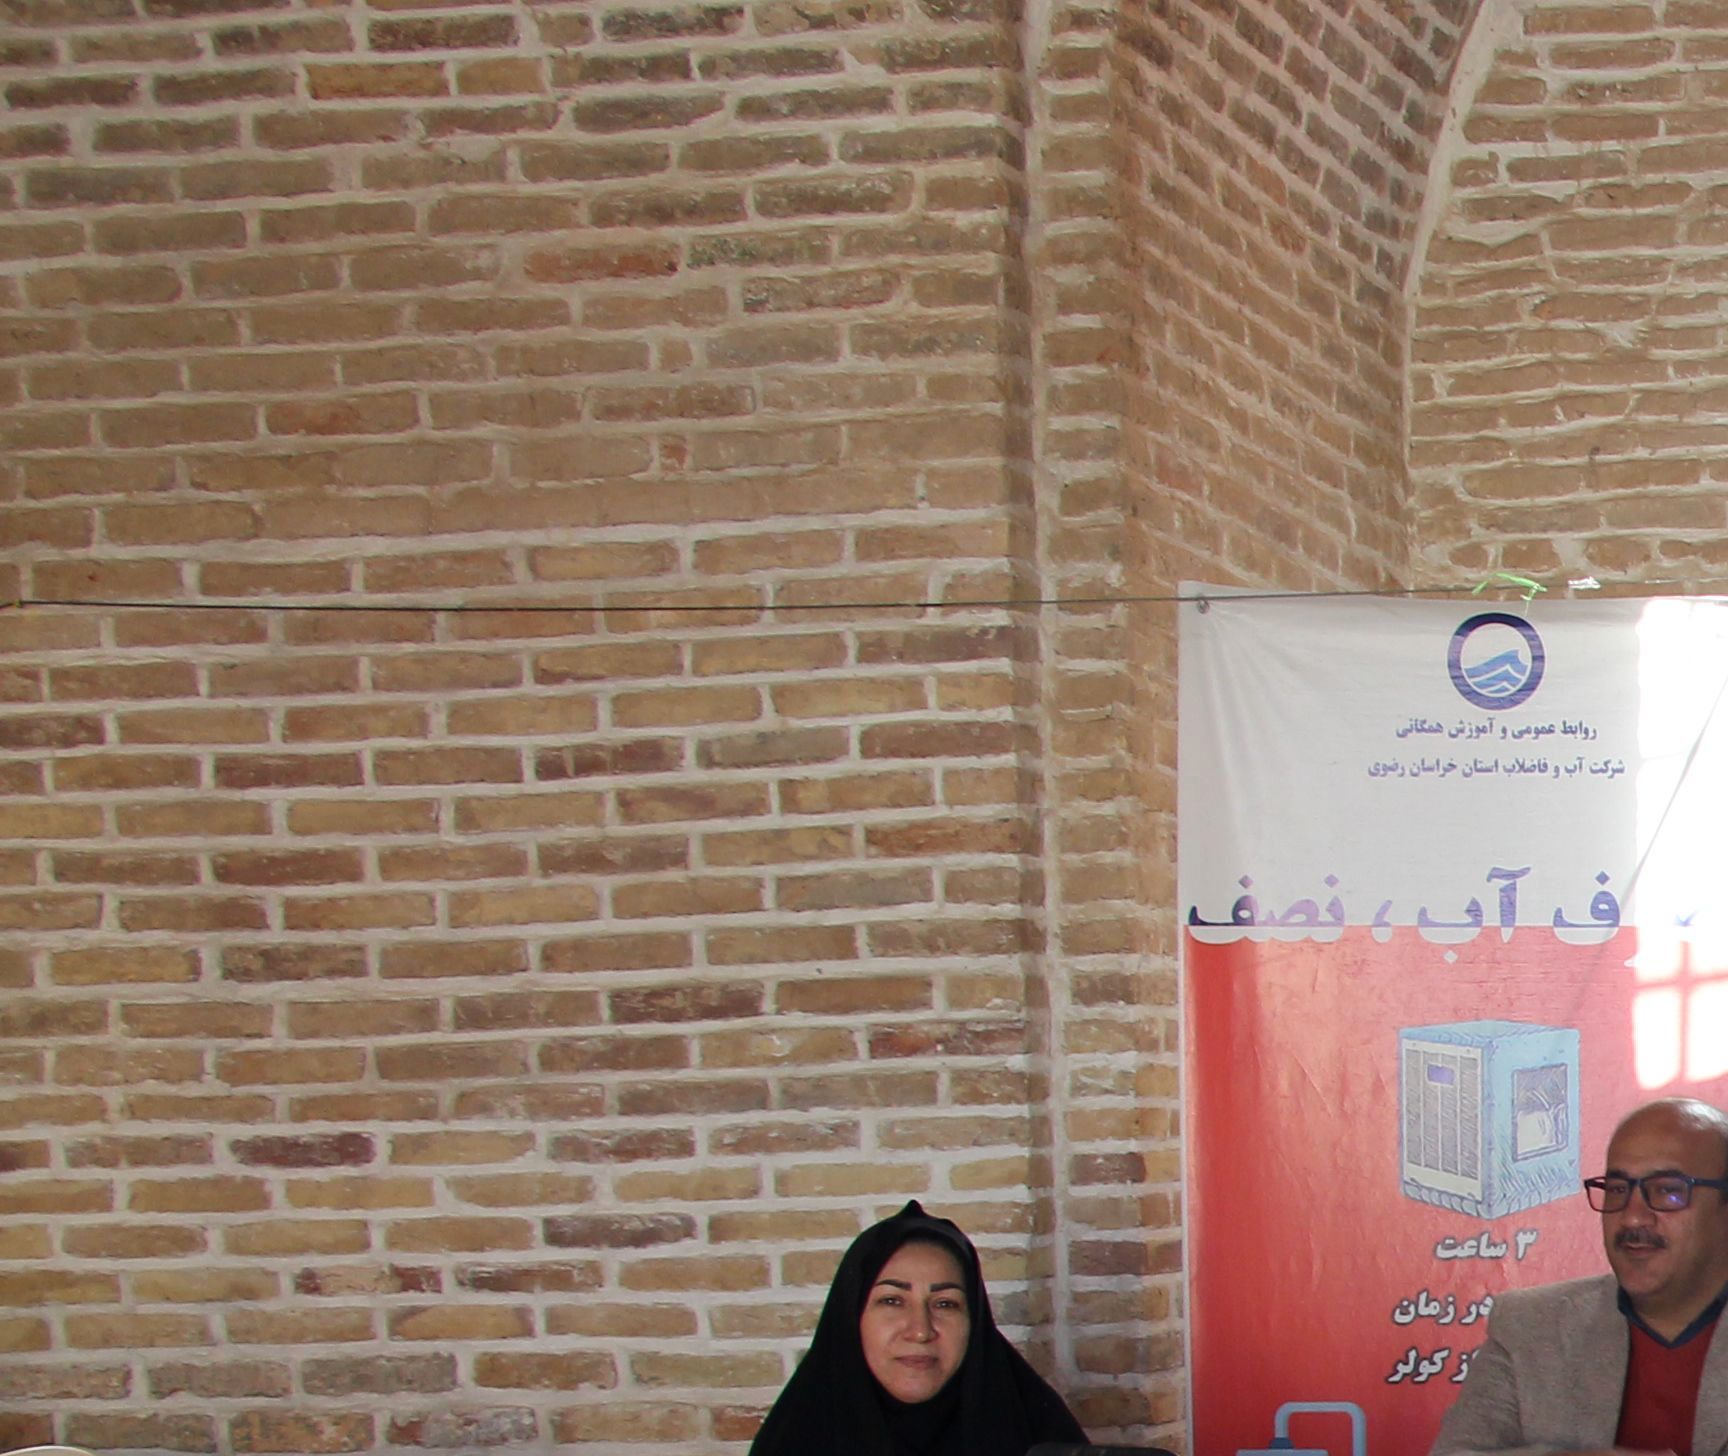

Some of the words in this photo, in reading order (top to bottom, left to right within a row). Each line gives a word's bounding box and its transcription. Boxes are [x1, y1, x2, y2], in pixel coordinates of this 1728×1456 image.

[1395, 718, 1444, 739] همگانی
[1447, 716, 1496, 740] آموزش
[1499, 725, 1507, 739] و
[1511, 723, 1556, 740] عمومی
[1560, 720, 1598, 740] روابط
[1367, 759, 1406, 778] رضوی
[1408, 757, 1458, 778] خراسان
[1461, 757, 1500, 778] استان
[1502, 757, 1550, 778] فاضلاب
[1552, 763, 1560, 779] و
[1564, 756, 1585, 776] آب
[1588, 758, 1626, 779] شرکت
[1187, 873, 1346, 945] نصف
[1435, 1232, 1507, 1260] ساعت
[1514, 1229, 1539, 1260] ۳
[1392, 1289, 1457, 1326] زمان
[1385, 1348, 1450, 1385] کولر
[1451, 1349, 1480, 1384] ز
